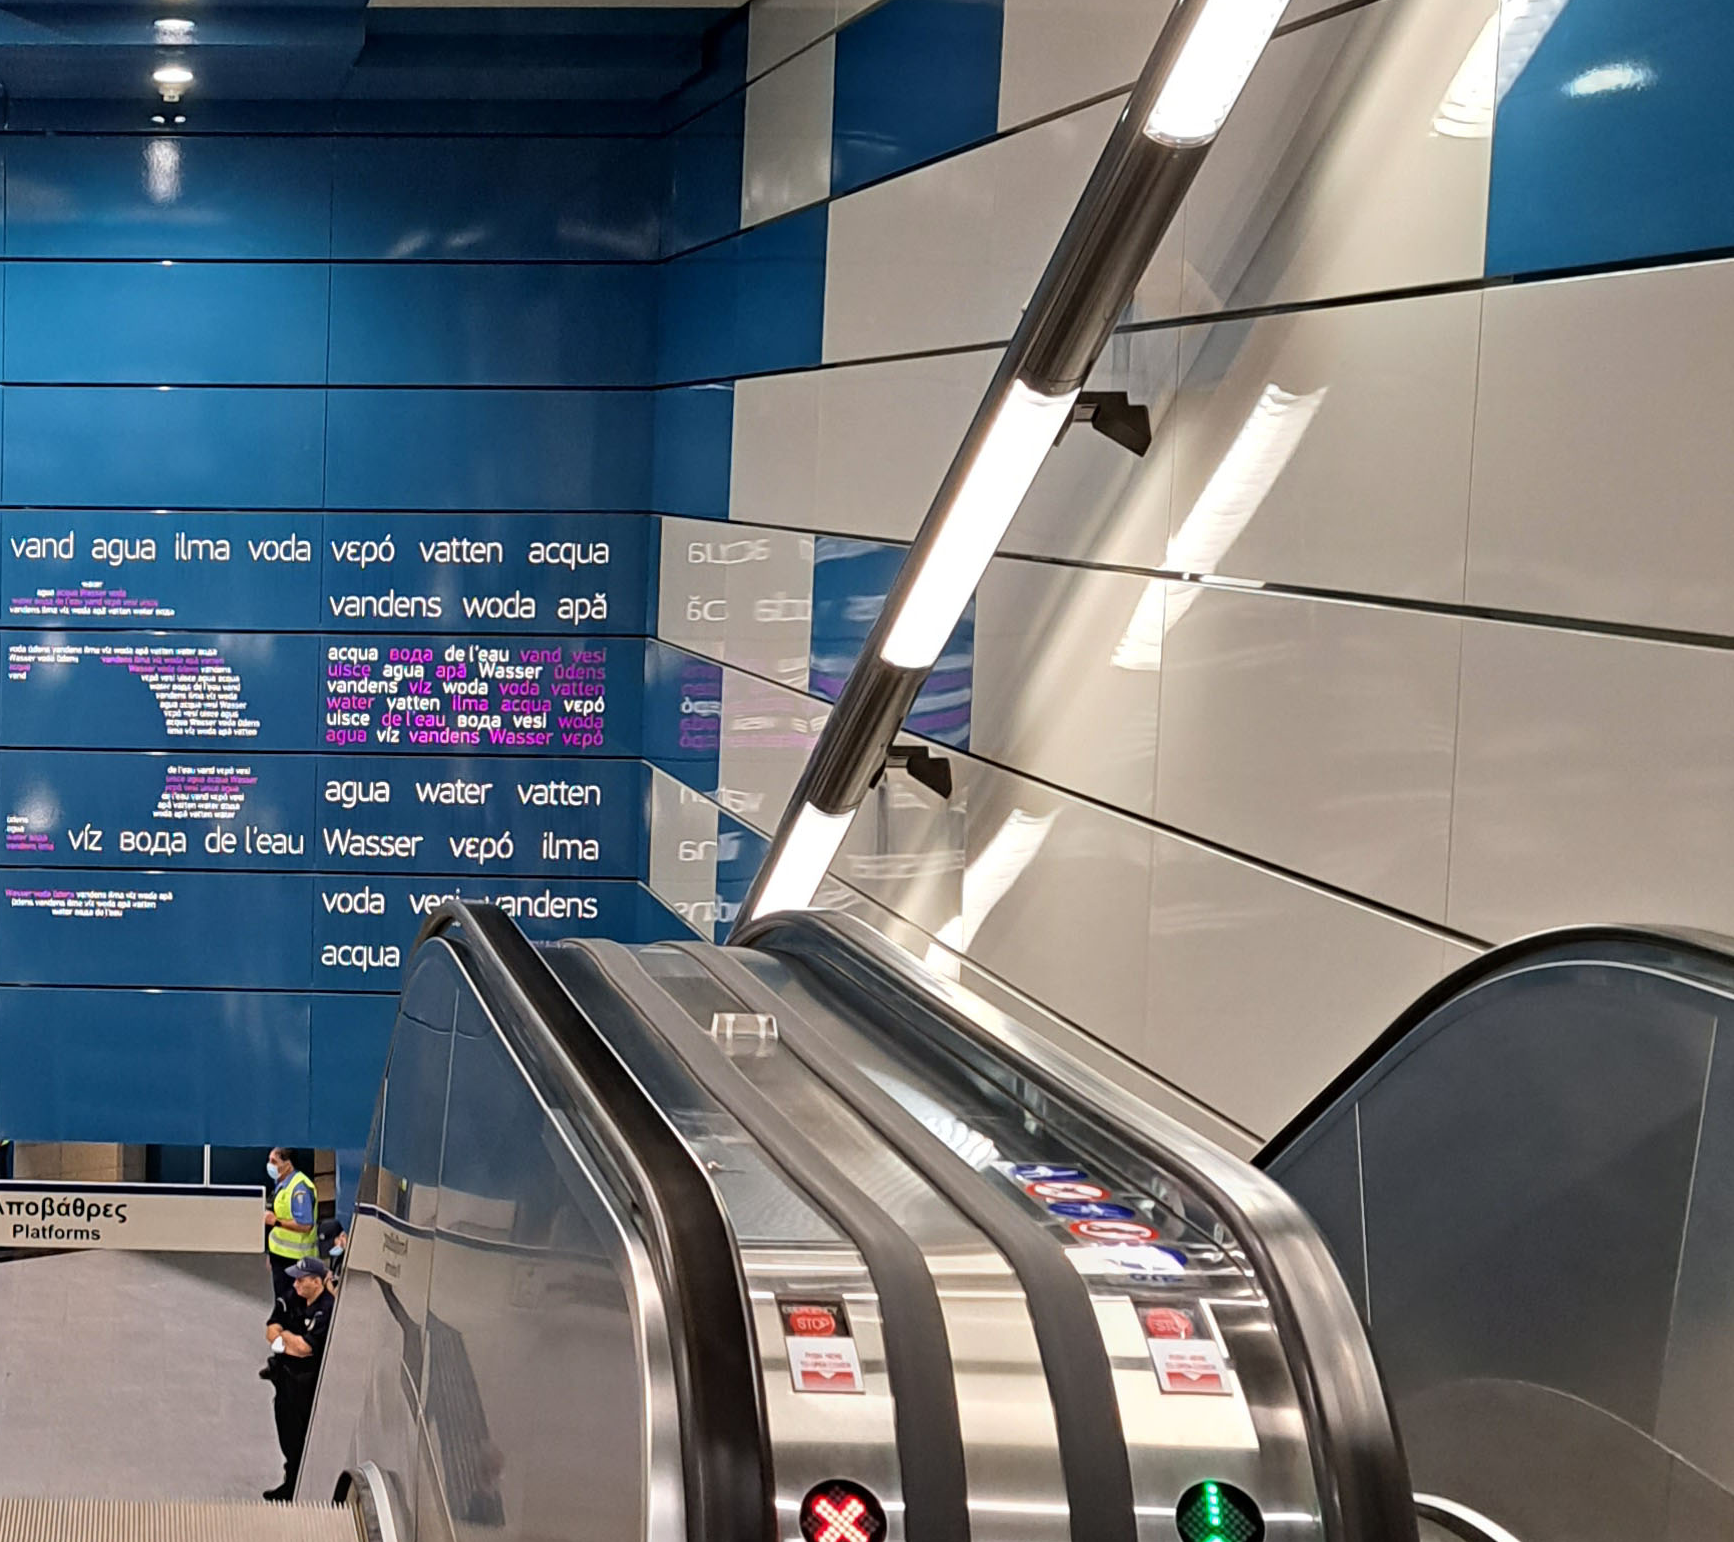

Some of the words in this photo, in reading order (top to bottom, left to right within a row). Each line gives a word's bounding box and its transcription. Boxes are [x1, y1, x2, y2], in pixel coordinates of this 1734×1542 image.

[11, 531, 74, 559] vand
[92, 539, 156, 565] agua
[175, 532, 230, 561] ilma
[248, 533, 311, 561] voda
[332, 534, 395, 568] νερό
[420, 538, 503, 563] vatten
[528, 542, 609, 570] acqua
[330, 589, 442, 617] vandens
[463, 590, 535, 618] woda
[557, 593, 607, 625] apă
[329, 648, 378, 662] acqua
[389, 648, 432, 663] вода
[520, 645, 561, 661] vand
[572, 646, 606, 662] vesi
[328, 662, 370, 676] uisce
[383, 664, 424, 678] agua
[435, 660, 466, 678] apă
[478, 662, 543, 677] Wasser
[553, 662, 606, 679] ūdens
[328, 677, 397, 693] vandens
[409, 678, 432, 693] víz
[442, 678, 488, 694] woda
[499, 679, 539, 694] voda
[550, 681, 603, 695] vatten
[327, 695, 375, 709] water
[386, 695, 440, 709] vatten
[450, 694, 488, 710] ilma
[500, 699, 551, 713] acqua
[562, 695, 604, 714] νερό
[327, 709, 369, 725] uisce
[456, 715, 501, 729] вода
[512, 712, 546, 727] vesi
[557, 712, 602, 728] woda
[326, 729, 366, 744] agua
[377, 726, 399, 741] víz
[410, 727, 479, 742] vandens
[490, 727, 552, 743] Wasser
[562, 728, 602, 747] νερό
[325, 781, 390, 808] agua
[416, 779, 493, 804] water
[517, 781, 600, 805] vatten
[68, 824, 102, 851] víz
[120, 831, 186, 856] вода
[323, 828, 423, 857] Wasser
[450, 831, 513, 865] νερό
[543, 832, 599, 860] ilma
[322, 886, 384, 914] voda
[321, 945, 400, 972] acqua
[12, 1223, 101, 1241] Platforms
[796, 1317, 830, 1331] STOP
